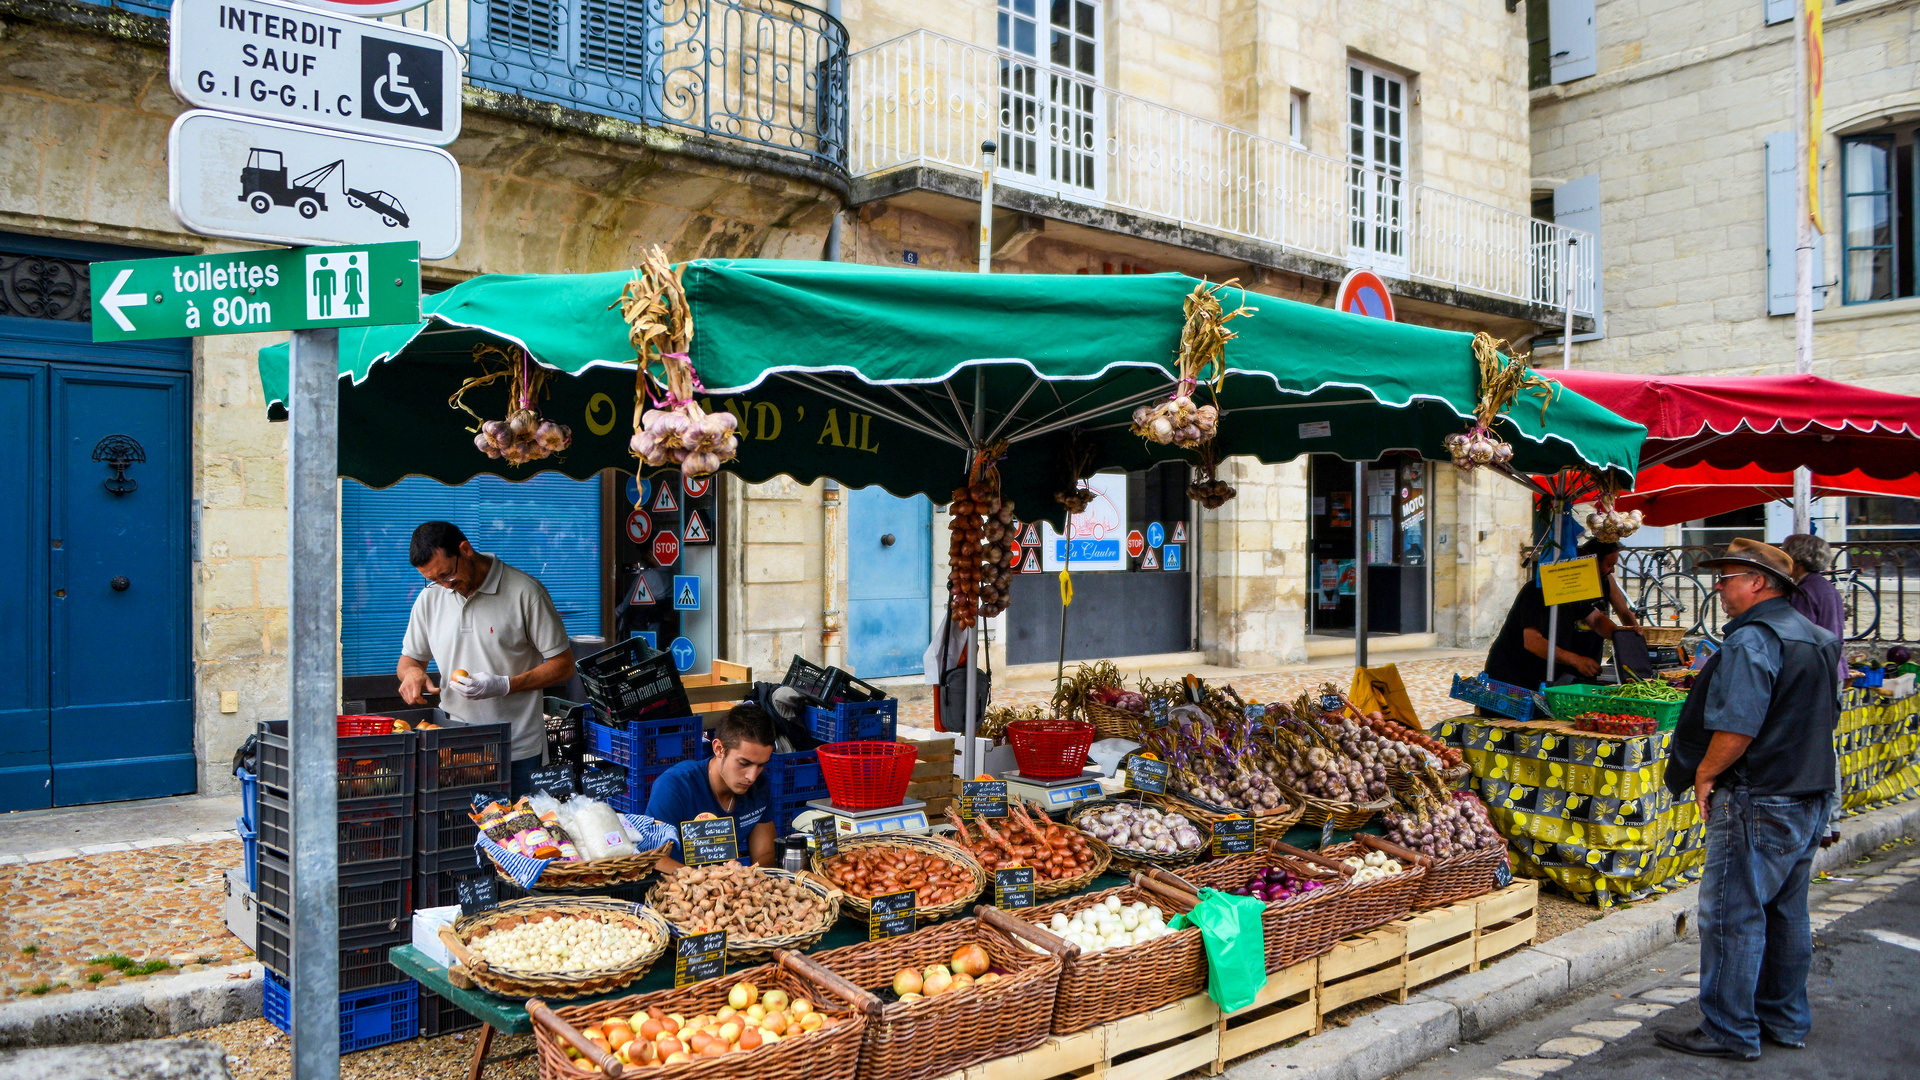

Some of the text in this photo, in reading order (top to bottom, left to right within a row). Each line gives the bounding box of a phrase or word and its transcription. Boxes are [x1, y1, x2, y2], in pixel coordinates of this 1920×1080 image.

[220, 5, 342, 50] INTERDIT
[242, 44, 317, 77] SAUF
[907, 252, 914, 263] 6
[173, 262, 279, 293] toilettes
[186, 296, 271, 329] à 80m
[1402, 495, 1425, 517] MOTO
[655, 542, 677, 554] STOP
[1127, 539, 1142, 548] STOP
[1568, 765, 1576, 790] OLIVES
[1623, 773, 1631, 798] OLIVES
[1513, 805, 1535, 813] CITRONS
